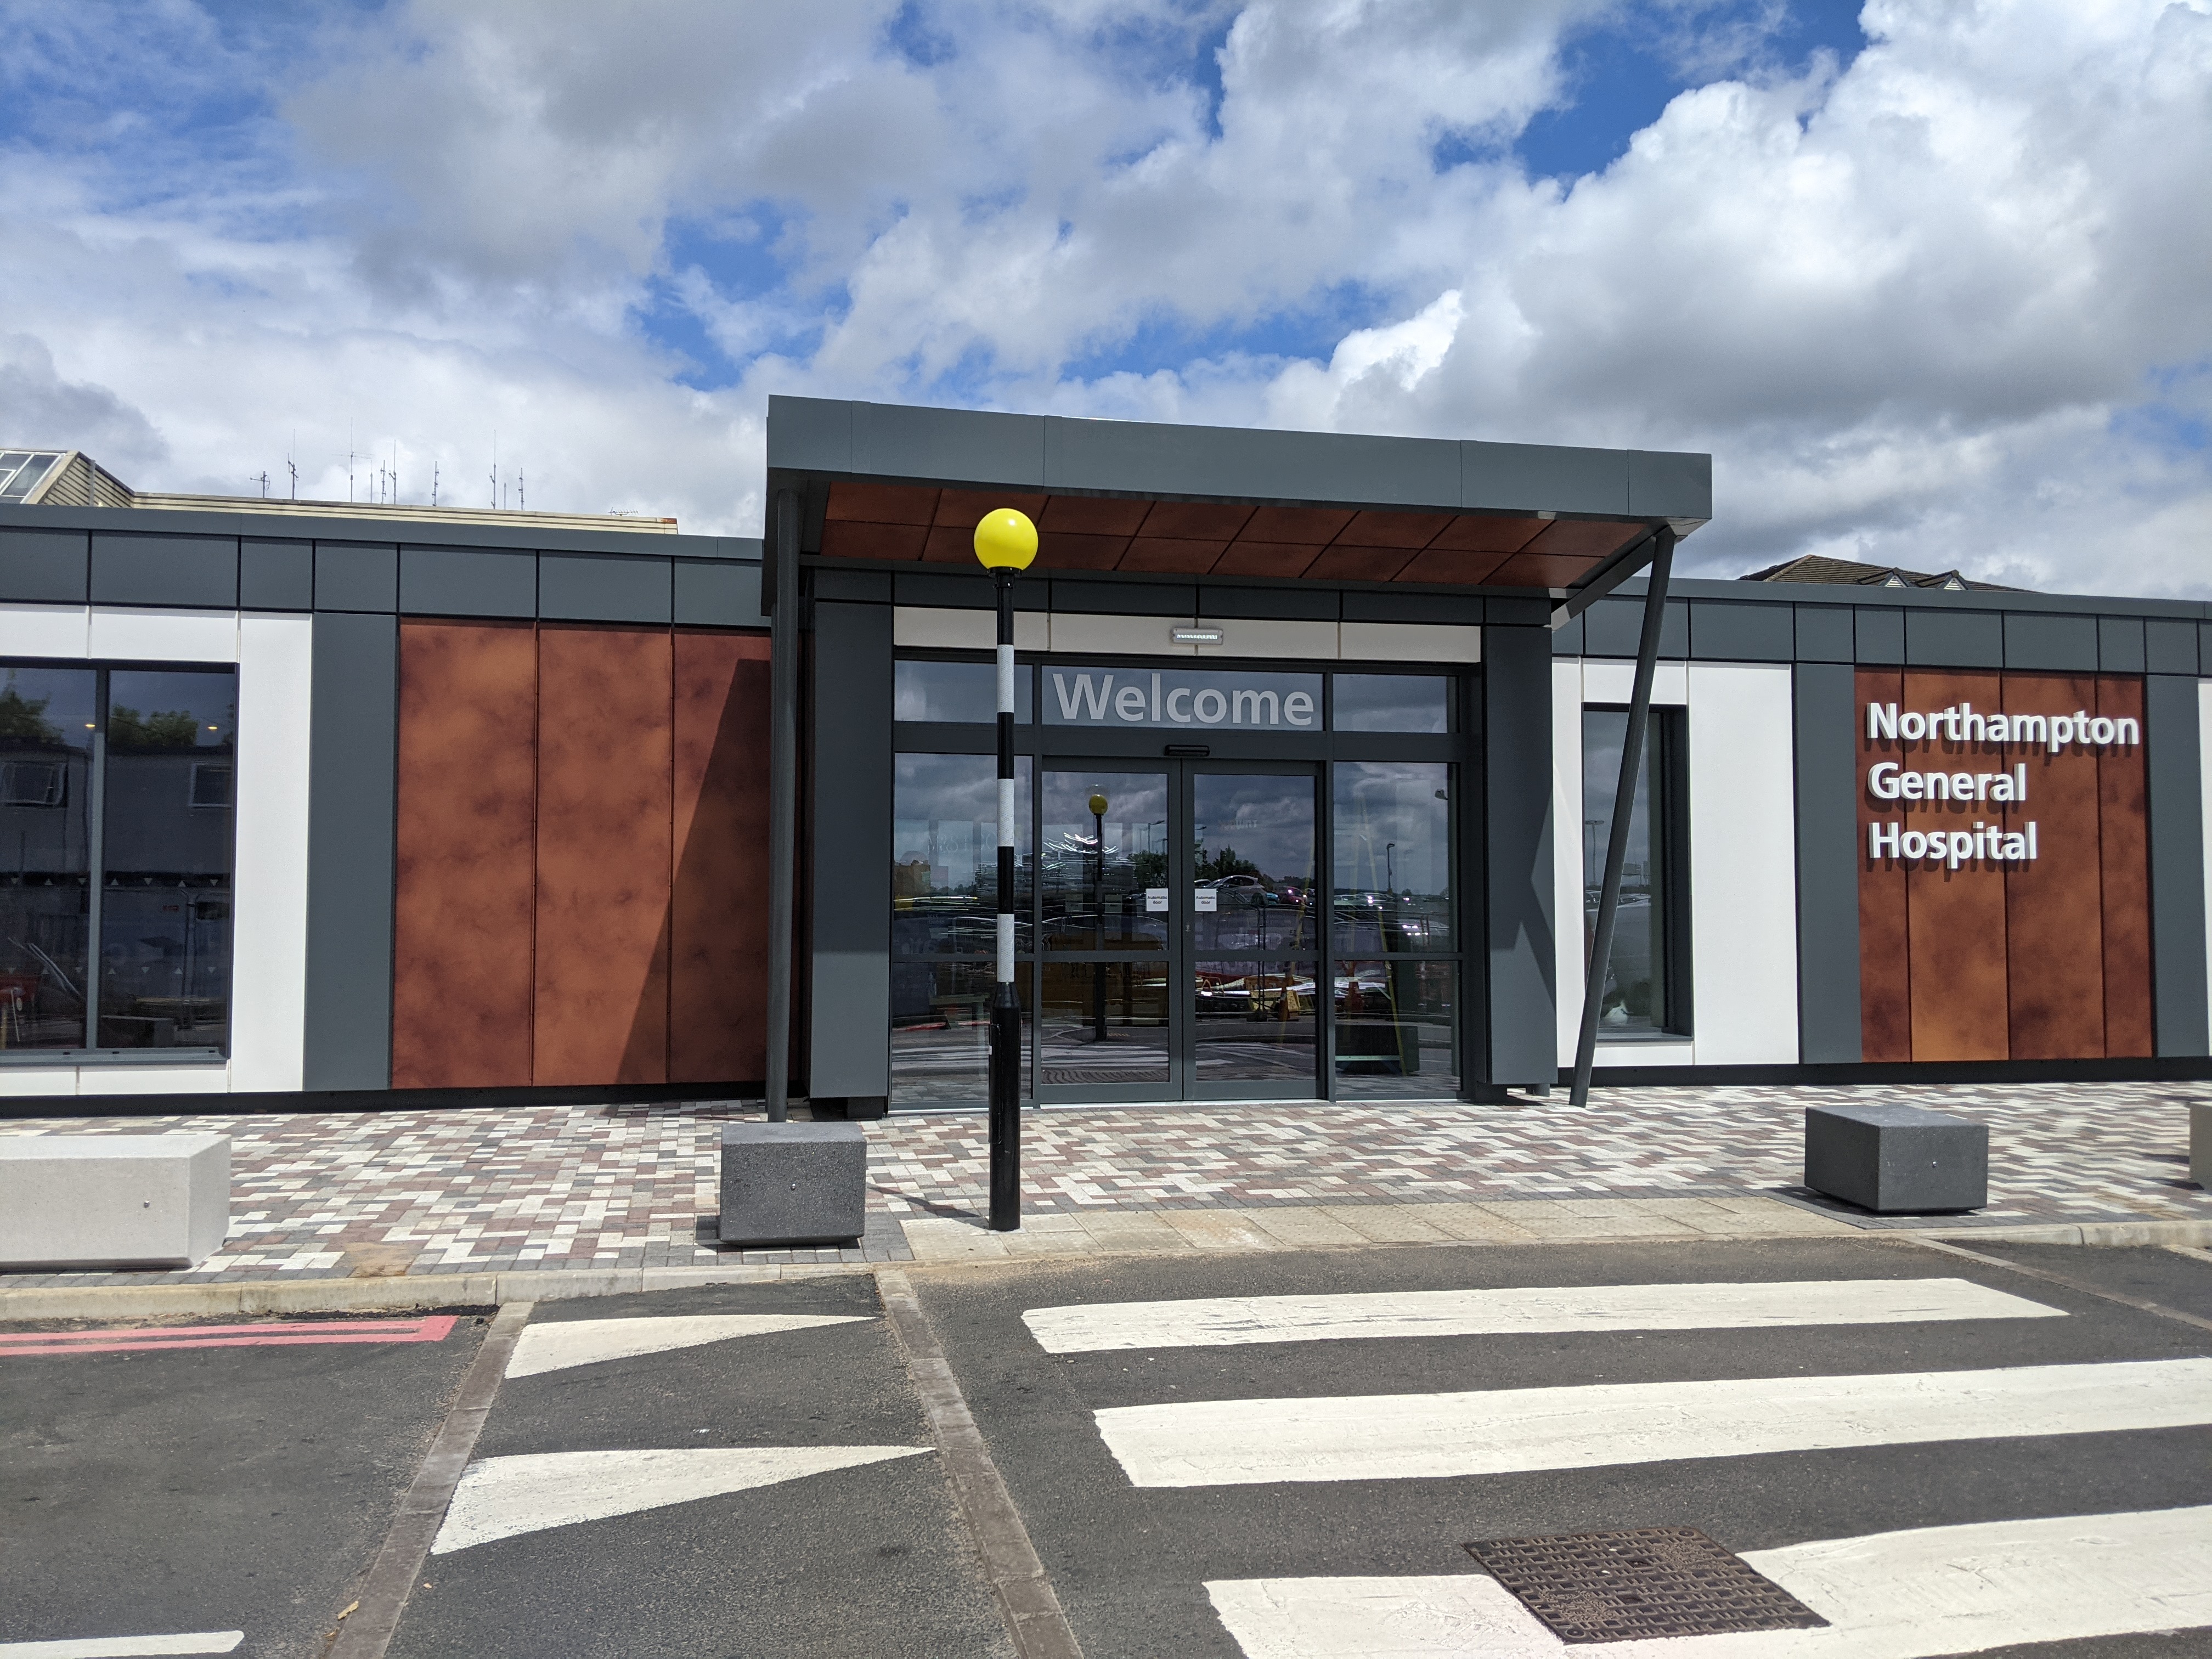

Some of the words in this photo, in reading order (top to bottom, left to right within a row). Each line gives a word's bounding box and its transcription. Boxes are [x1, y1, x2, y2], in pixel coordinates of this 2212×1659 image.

[1052, 673, 1314, 726] Welcome
[1866, 702, 2139, 753] Northampton
[1867, 761, 2027, 802] General
[1868, 821, 2038, 869] Hospital
